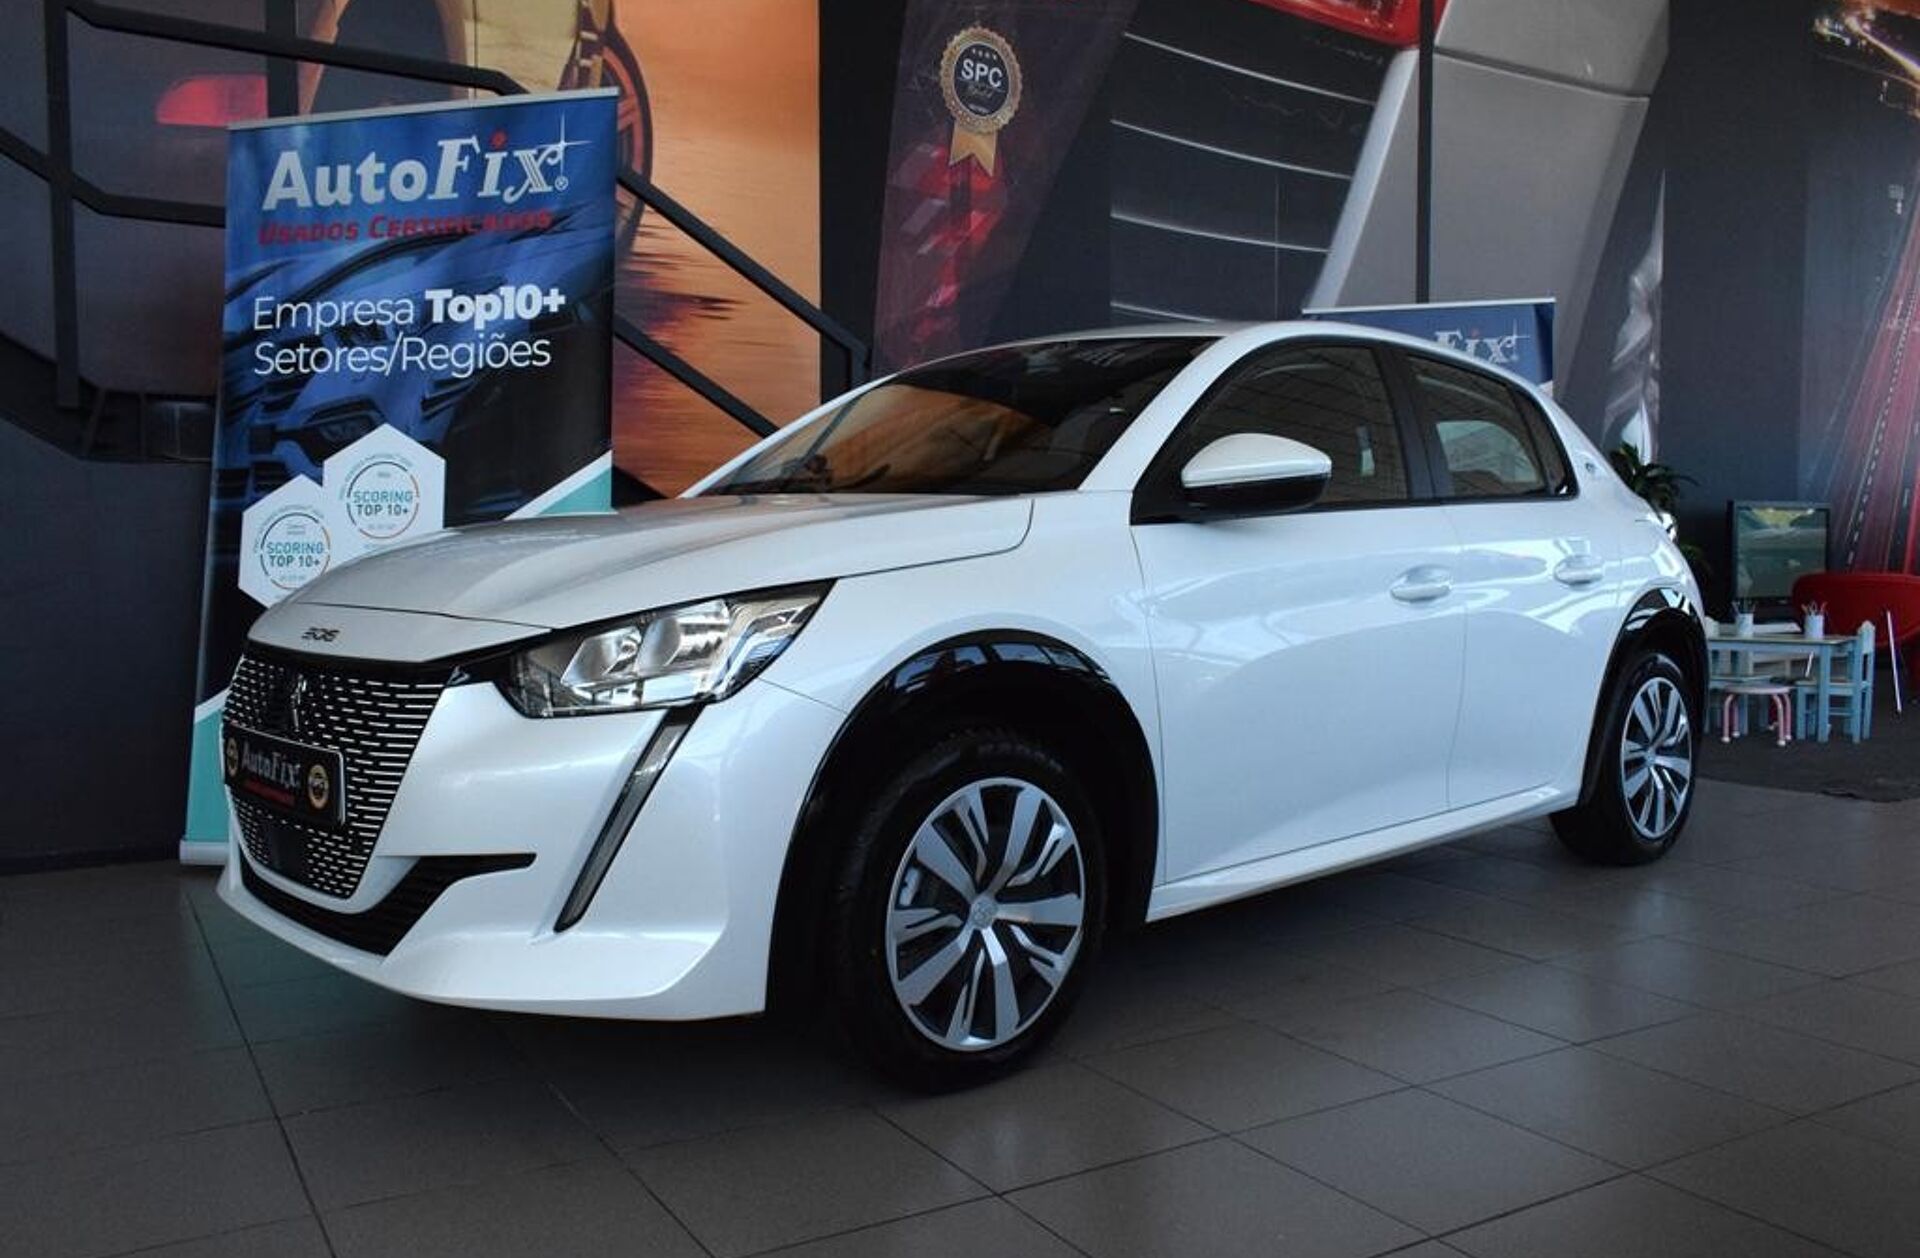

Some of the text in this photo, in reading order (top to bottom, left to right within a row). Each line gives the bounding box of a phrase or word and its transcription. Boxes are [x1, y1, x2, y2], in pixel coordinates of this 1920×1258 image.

[961, 58, 1002, 87] SPC
[254, 284, 566, 335] Empresa Top10+
[254, 333, 551, 378] Setores/Regiões
[353, 490, 413, 503] SCORING
[357, 503, 409, 516] TOP 10+
[266, 542, 324, 555] SCORING
[268, 555, 320, 568] TOP 10+
